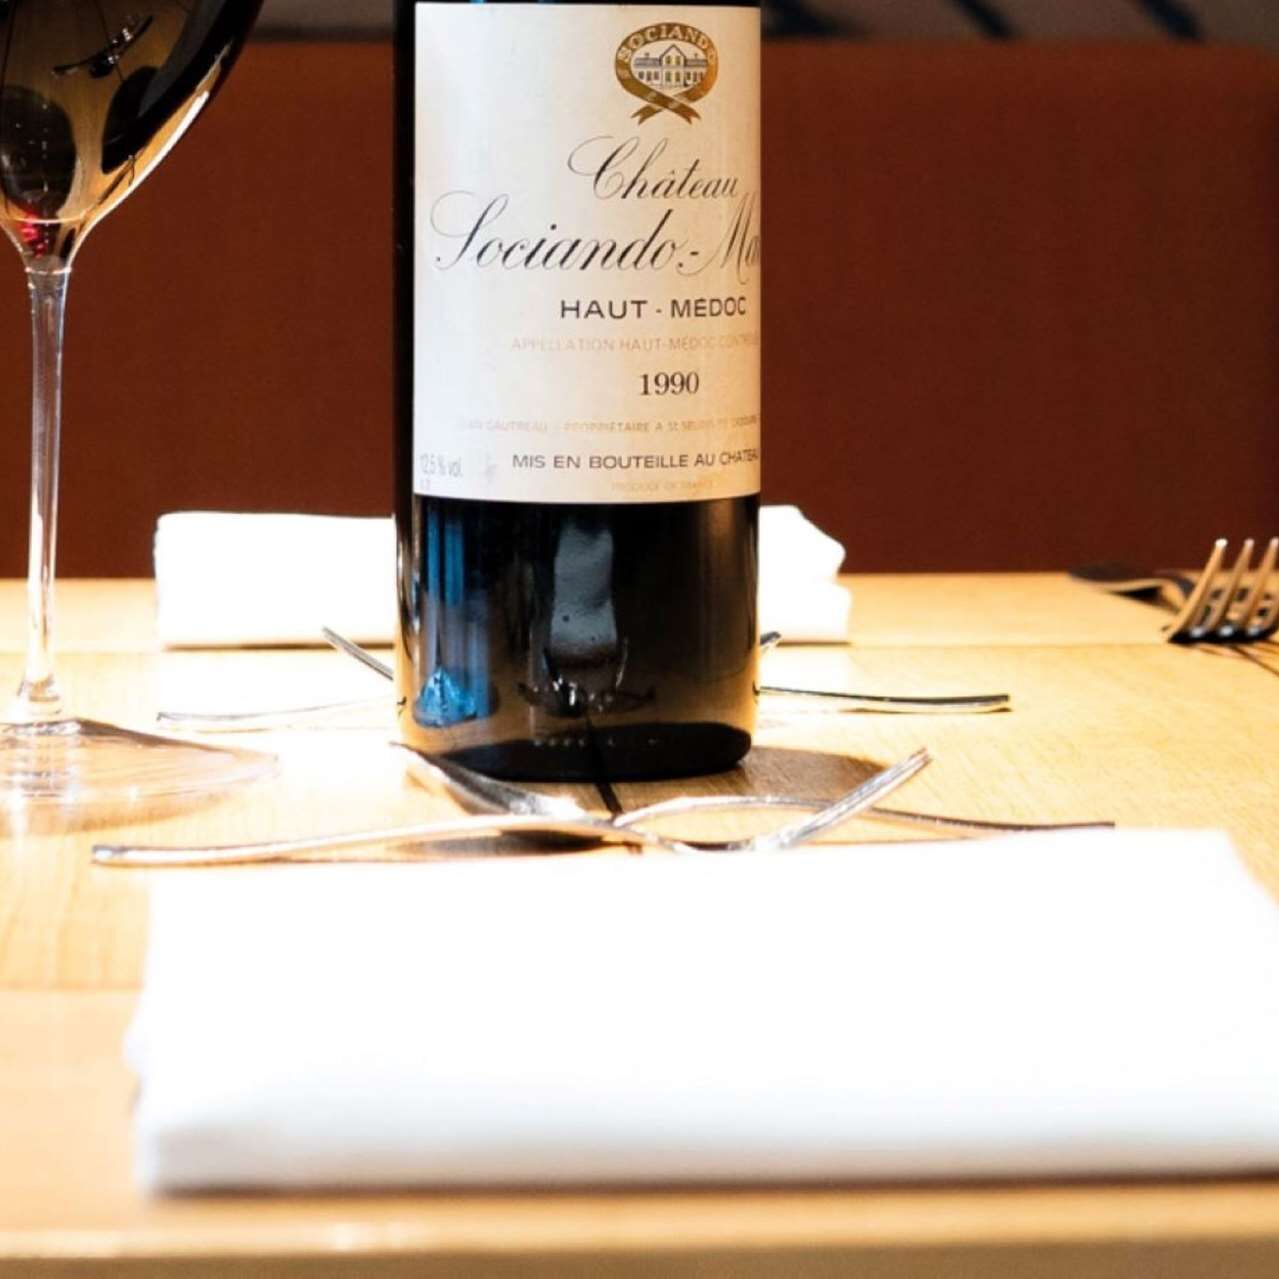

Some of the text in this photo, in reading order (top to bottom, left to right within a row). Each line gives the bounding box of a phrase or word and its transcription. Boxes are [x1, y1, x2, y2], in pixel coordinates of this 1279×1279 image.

[567, 135, 739, 200] Château
[560, 298, 648, 320] HAUT
[638, 371, 700, 396] 1990
[511, 454, 546, 469] MIS
[553, 453, 581, 469] EN
[589, 453, 689, 470] BOUTEILLE
[694, 452, 716, 468] AU
